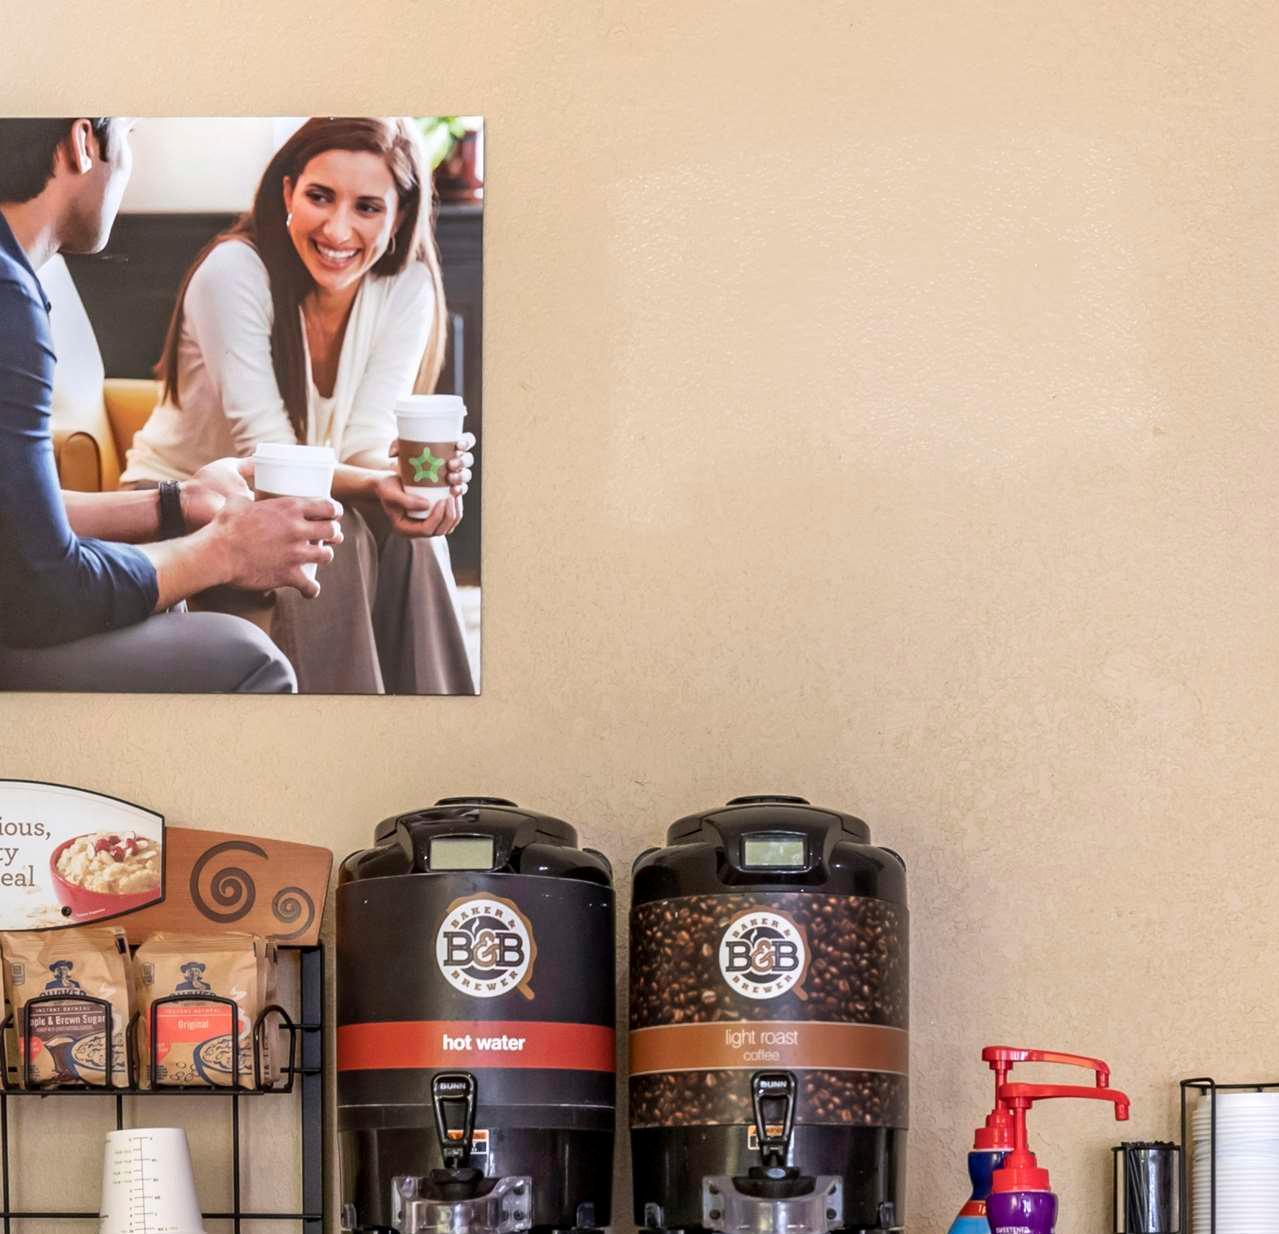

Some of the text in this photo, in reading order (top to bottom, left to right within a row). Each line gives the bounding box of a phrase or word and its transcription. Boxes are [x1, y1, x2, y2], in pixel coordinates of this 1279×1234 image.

[451, 906, 504, 929] BAKER
[442, 930, 525, 967] B&B
[724, 940, 800, 973] B&B
[451, 969, 519, 992] BREWER
[55, 1015, 81, 1025] Brown
[442, 1033, 526, 1051] hot water
[725, 1028, 799, 1049] light roast
[743, 1049, 780, 1061] coffee
[439, 1082, 466, 1090] BUNN
[760, 1080, 787, 1088] BUNN
